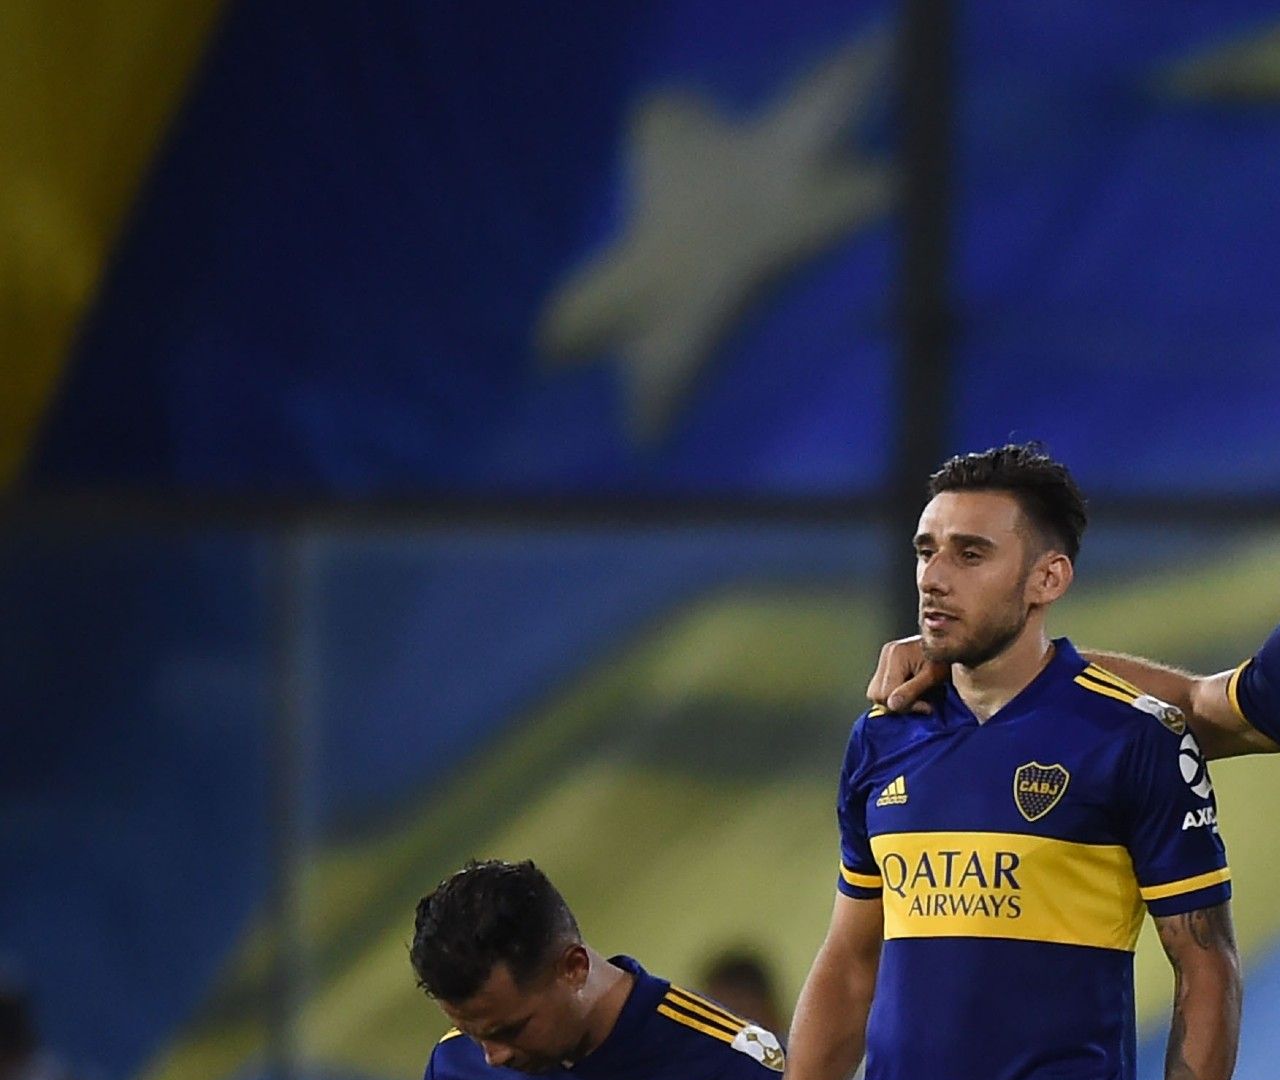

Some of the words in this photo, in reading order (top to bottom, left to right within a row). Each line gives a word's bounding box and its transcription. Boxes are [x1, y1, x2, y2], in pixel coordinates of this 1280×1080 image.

[1019, 780, 1059, 795] CABJ
[882, 851, 1021, 898] QATAR
[908, 893, 1021, 919] AIRWAYS
